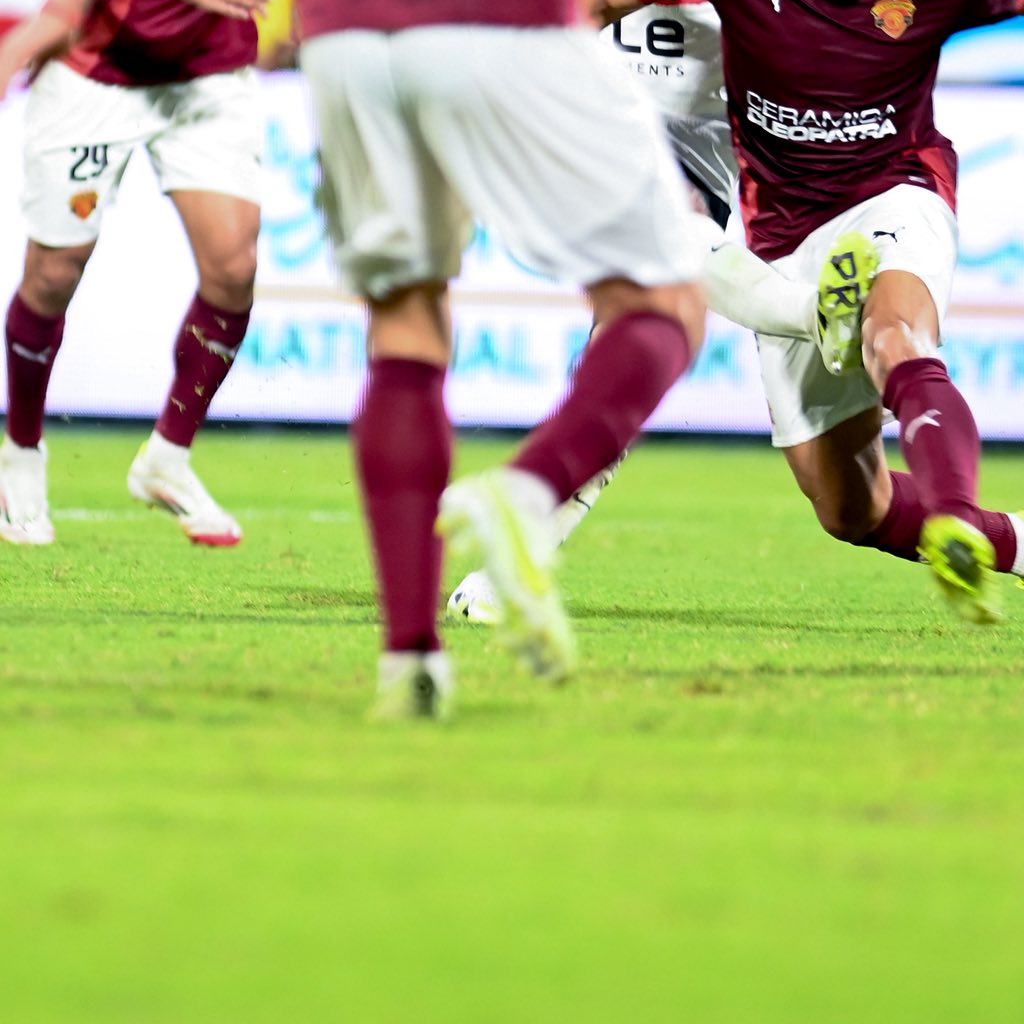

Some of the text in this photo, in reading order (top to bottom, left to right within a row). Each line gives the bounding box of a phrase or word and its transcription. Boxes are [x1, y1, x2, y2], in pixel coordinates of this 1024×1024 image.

[629, 62, 685, 77] ENTS
[746, 106, 897, 143] CLEOPATRA
[69, 144, 108, 180] 29
